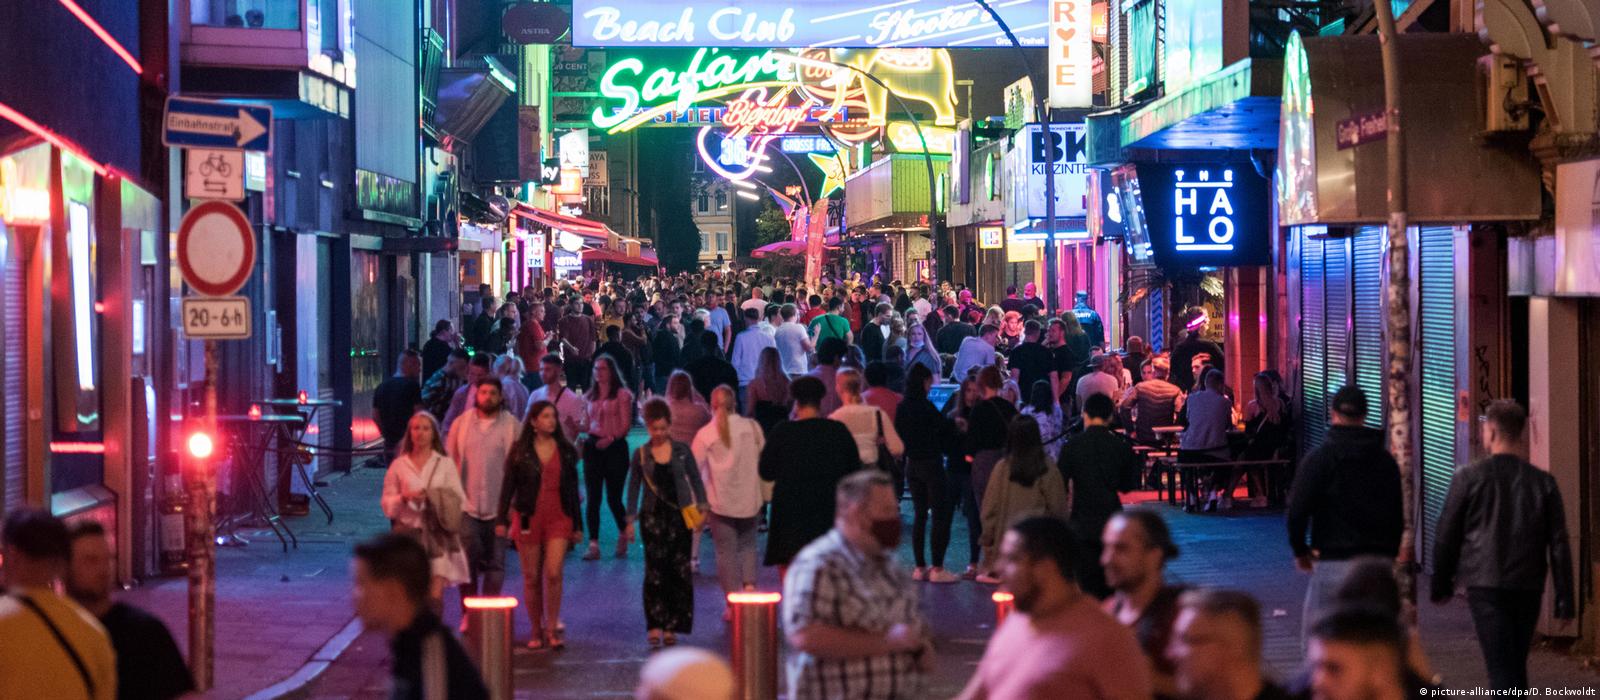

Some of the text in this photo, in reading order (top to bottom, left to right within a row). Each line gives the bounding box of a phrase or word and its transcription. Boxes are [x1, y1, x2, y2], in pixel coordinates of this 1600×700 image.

[583, 7, 796, 42] Beach Club
[720, 138, 747, 166] 36
[783, 138, 815, 152] GROSSE
[1031, 131, 1087, 163] BK
[541, 165, 559, 181] ky
[1031, 163, 1090, 175] KIZINTE
[1174, 169, 1233, 182] THE
